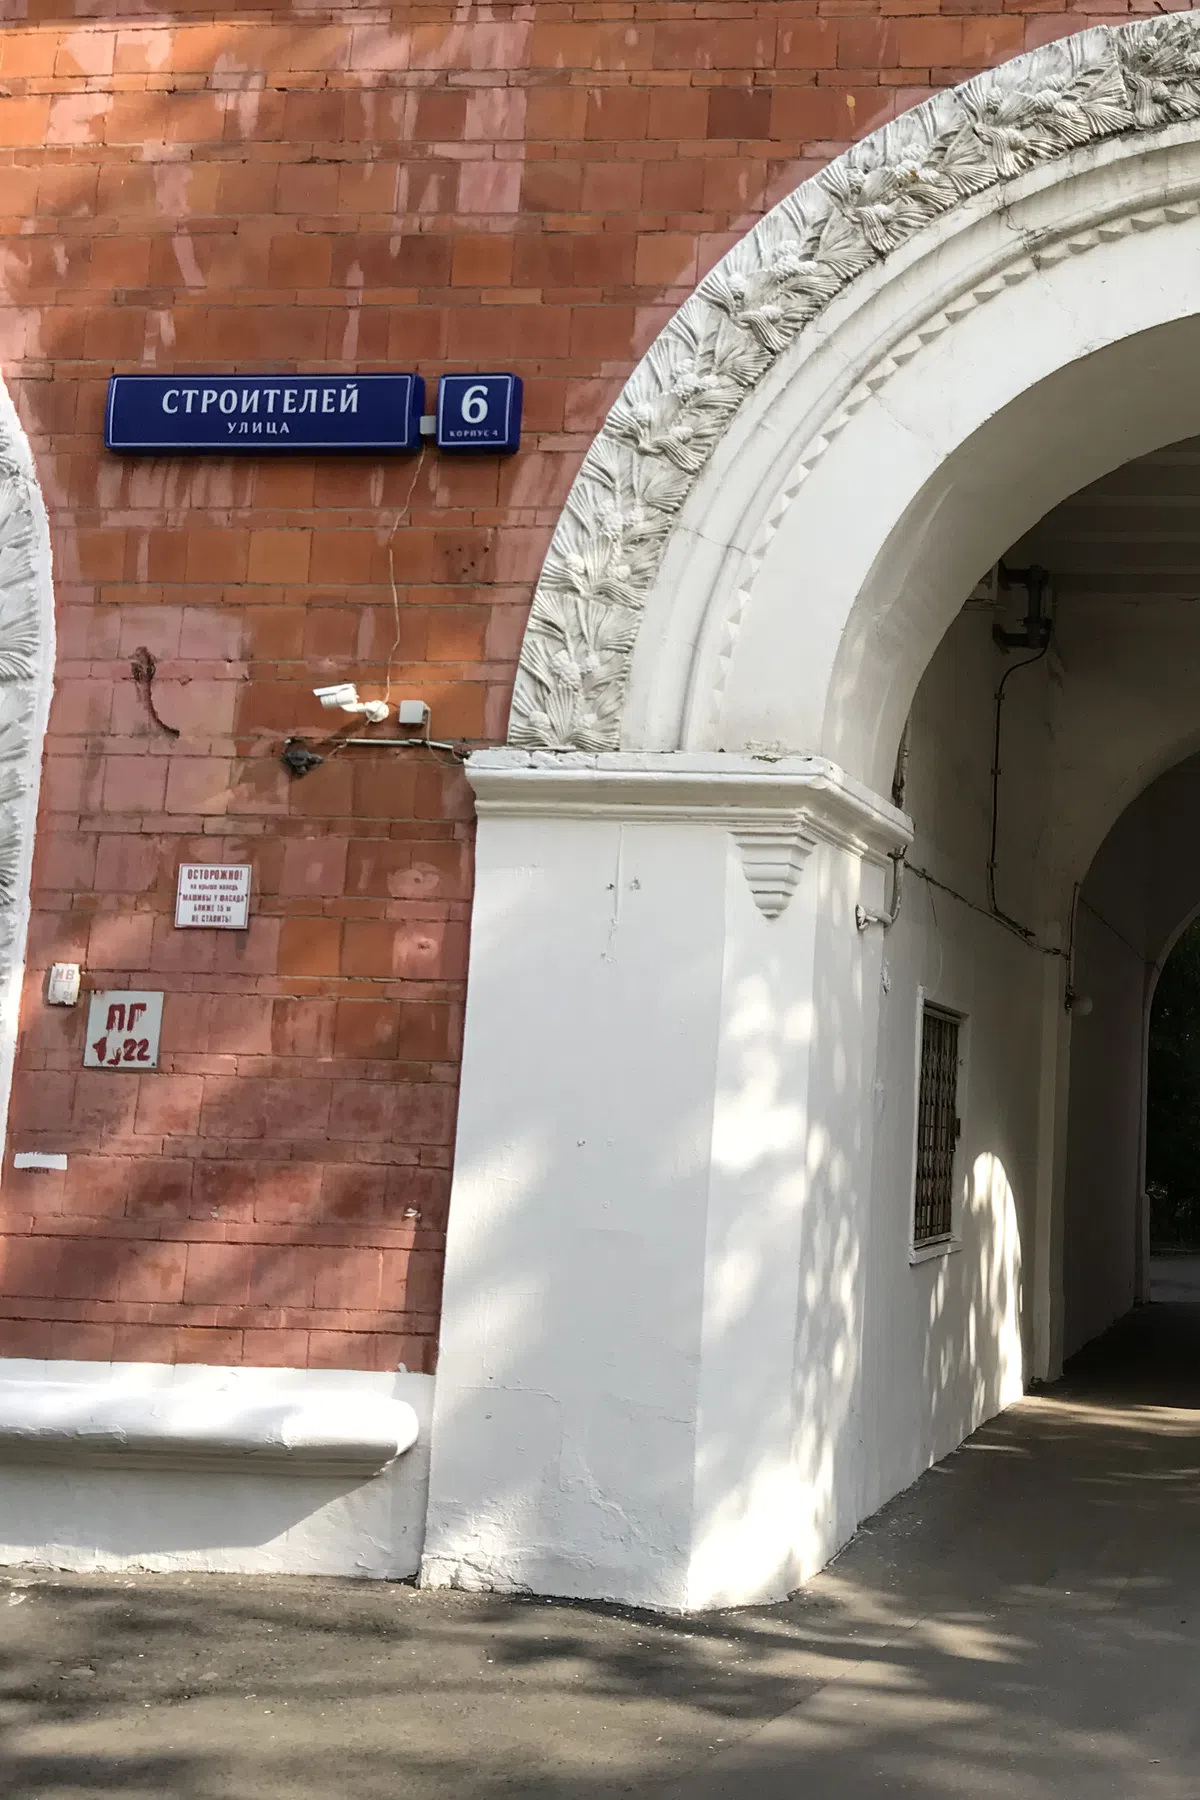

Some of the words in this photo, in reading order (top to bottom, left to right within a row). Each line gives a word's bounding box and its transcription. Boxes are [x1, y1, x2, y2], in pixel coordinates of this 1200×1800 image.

[161, 383, 360, 414] СТРОИТЕЛЕЙ
[461, 384, 489, 424] 6
[226, 421, 291, 435] УЛИЦА
[449, 429, 490, 437] КОРПУС
[492, 429, 498, 437] 4
[187, 869, 243, 880] ОСТОРОЖНО!
[219, 894, 245, 903] ФАСАДА
[193, 904, 215, 912] БЛИЖЕ
[105, 1003, 147, 1031] ПГ
